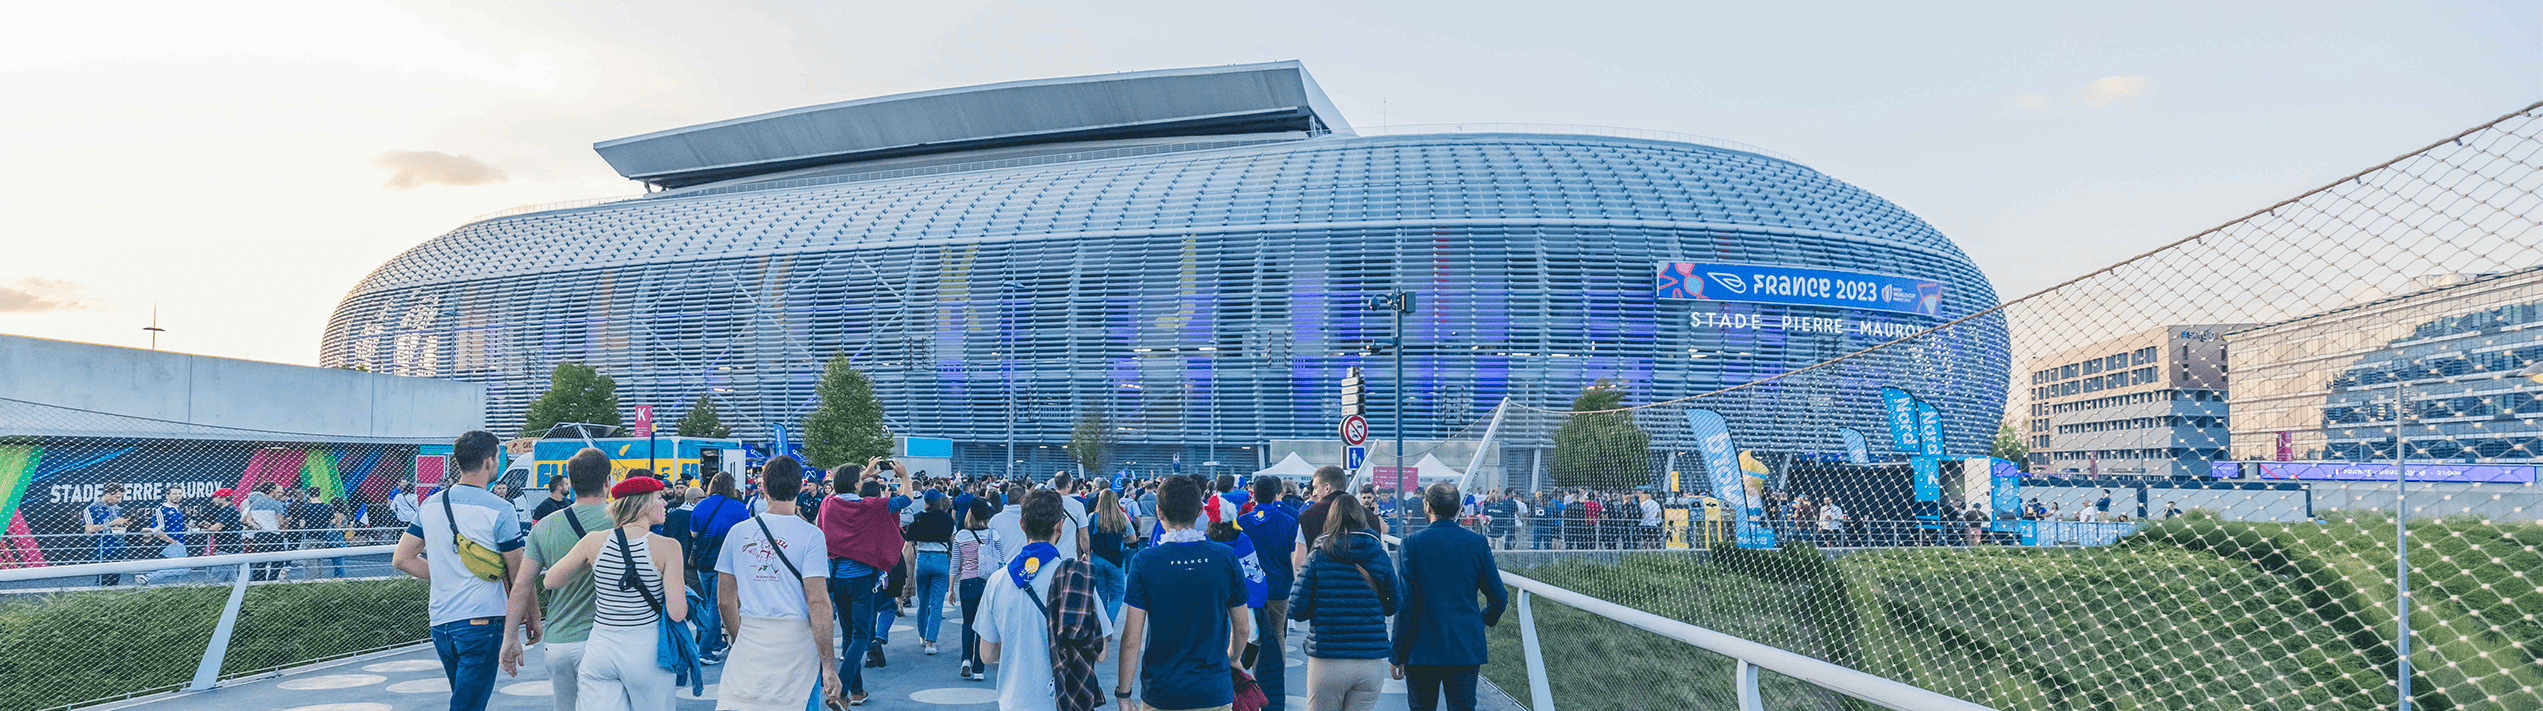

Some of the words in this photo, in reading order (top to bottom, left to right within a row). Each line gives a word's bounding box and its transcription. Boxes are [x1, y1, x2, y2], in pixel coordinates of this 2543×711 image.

[1836, 279, 1878, 302] 2023
[1690, 312, 1762, 330] STADE
[1781, 315, 1843, 334] PIERRE
[637, 407, 646, 421] K
[1894, 396, 1918, 445] Nord
[1921, 411, 1942, 456] Nord
[50, 483, 104, 503] STADE
[1170, 557, 1209, 566] FRANCE
